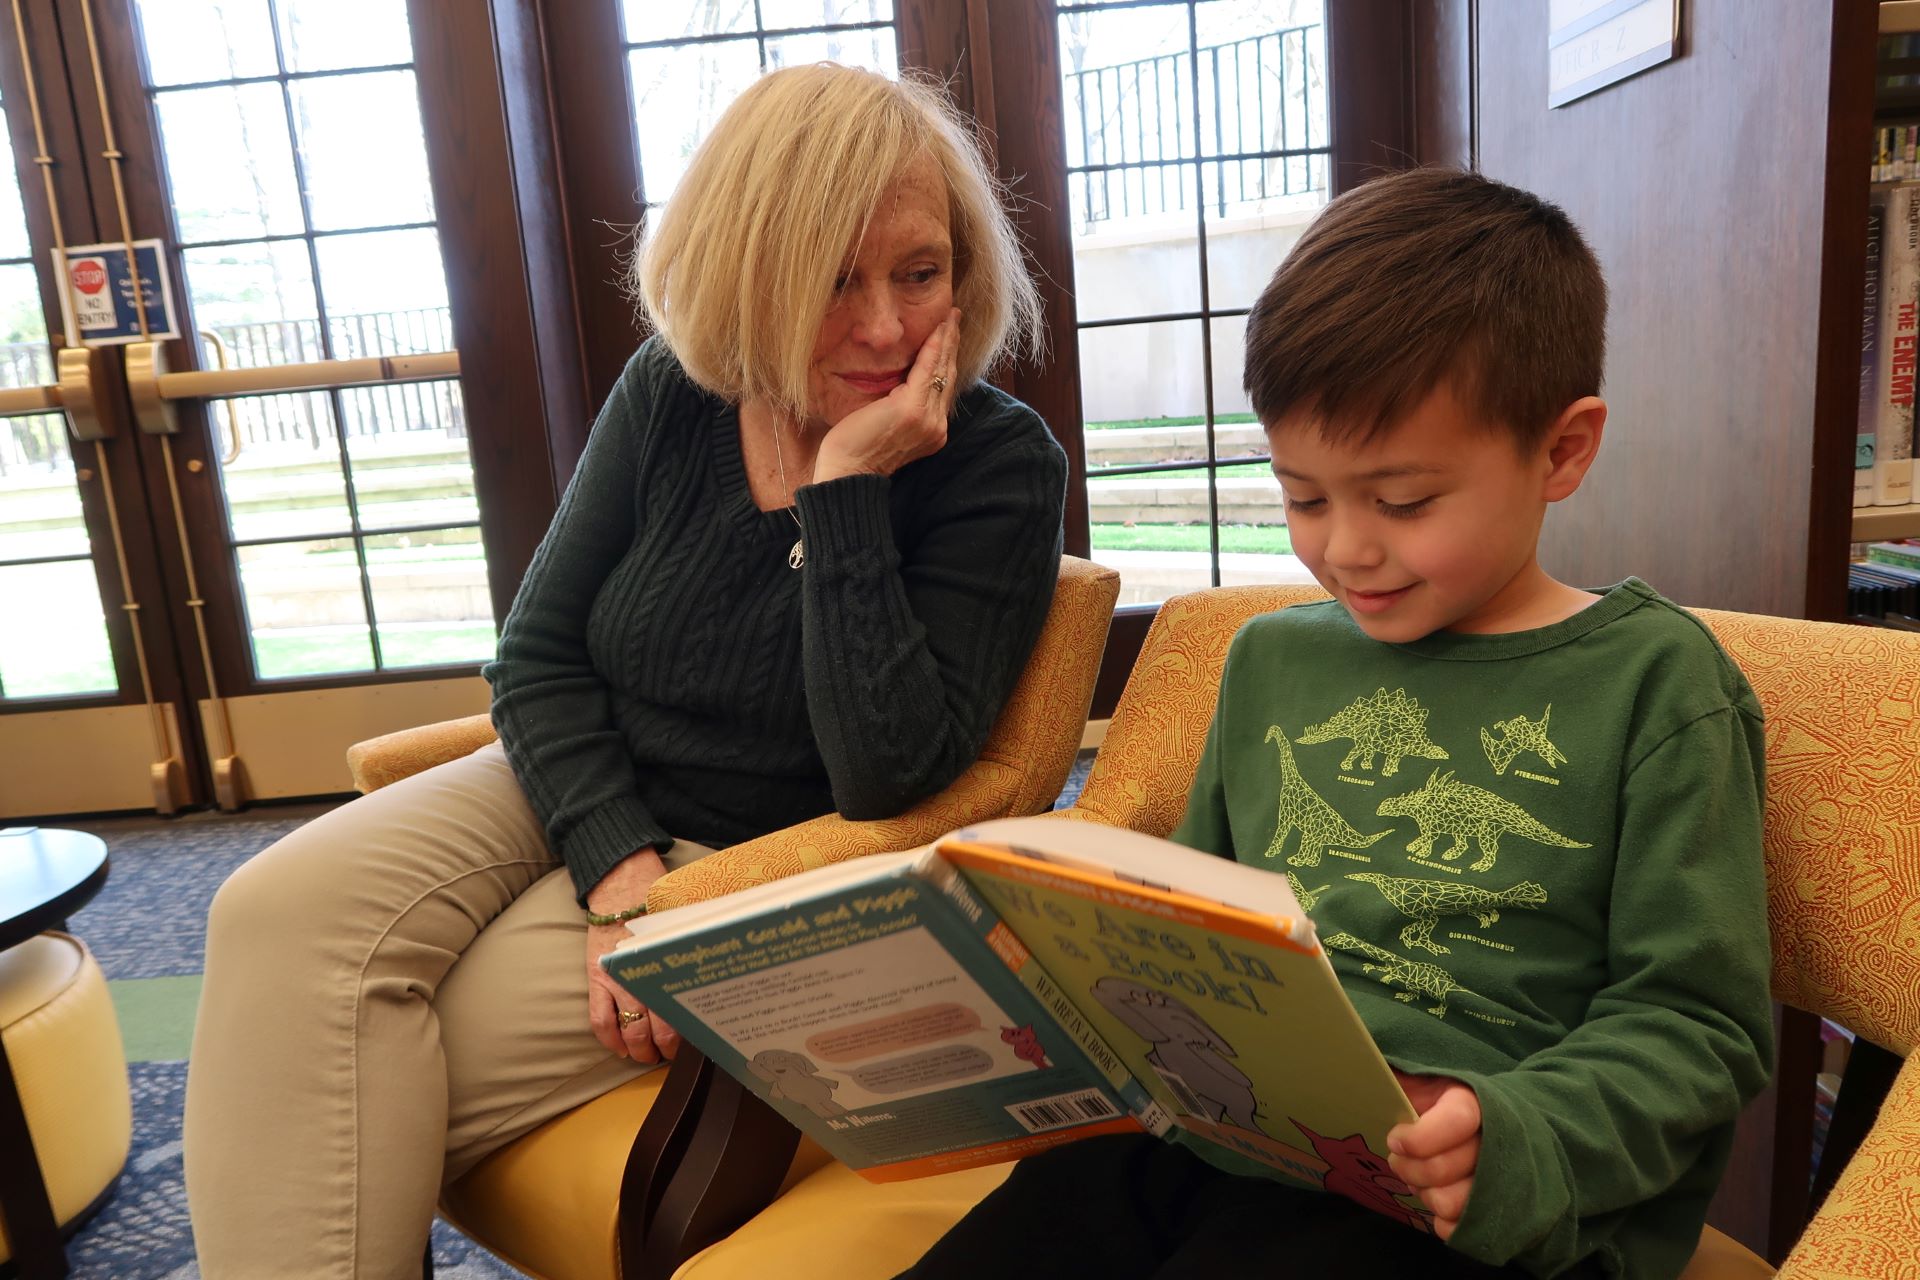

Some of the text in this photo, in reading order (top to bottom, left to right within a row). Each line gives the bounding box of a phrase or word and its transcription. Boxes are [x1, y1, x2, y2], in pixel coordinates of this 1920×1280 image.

[1866, 214, 1880, 263] ALICE
[74, 270, 106, 286] STOP
[85, 297, 101, 311] NO
[1862, 269, 1878, 352] HOFFMAN
[1890, 301, 1917, 406] THE ENEMY
[1337, 775, 1375, 787] STEGOSAURUS
[1514, 769, 1560, 786] PTERANODON
[1407, 855, 1462, 875] ACANTHOPHOLIS
[618, 886, 919, 981] Meet Elephant Gerald and Piggie
[986, 878, 1076, 928] We
[1093, 906, 1196, 961] Are
[1449, 932, 1515, 953] GIGANOTOSAURUS
[1090, 937, 1269, 1015] Book!
[1036, 975, 1119, 1074] WE ARE IN A BOOK!
[826, 1119, 849, 1131] Mo
